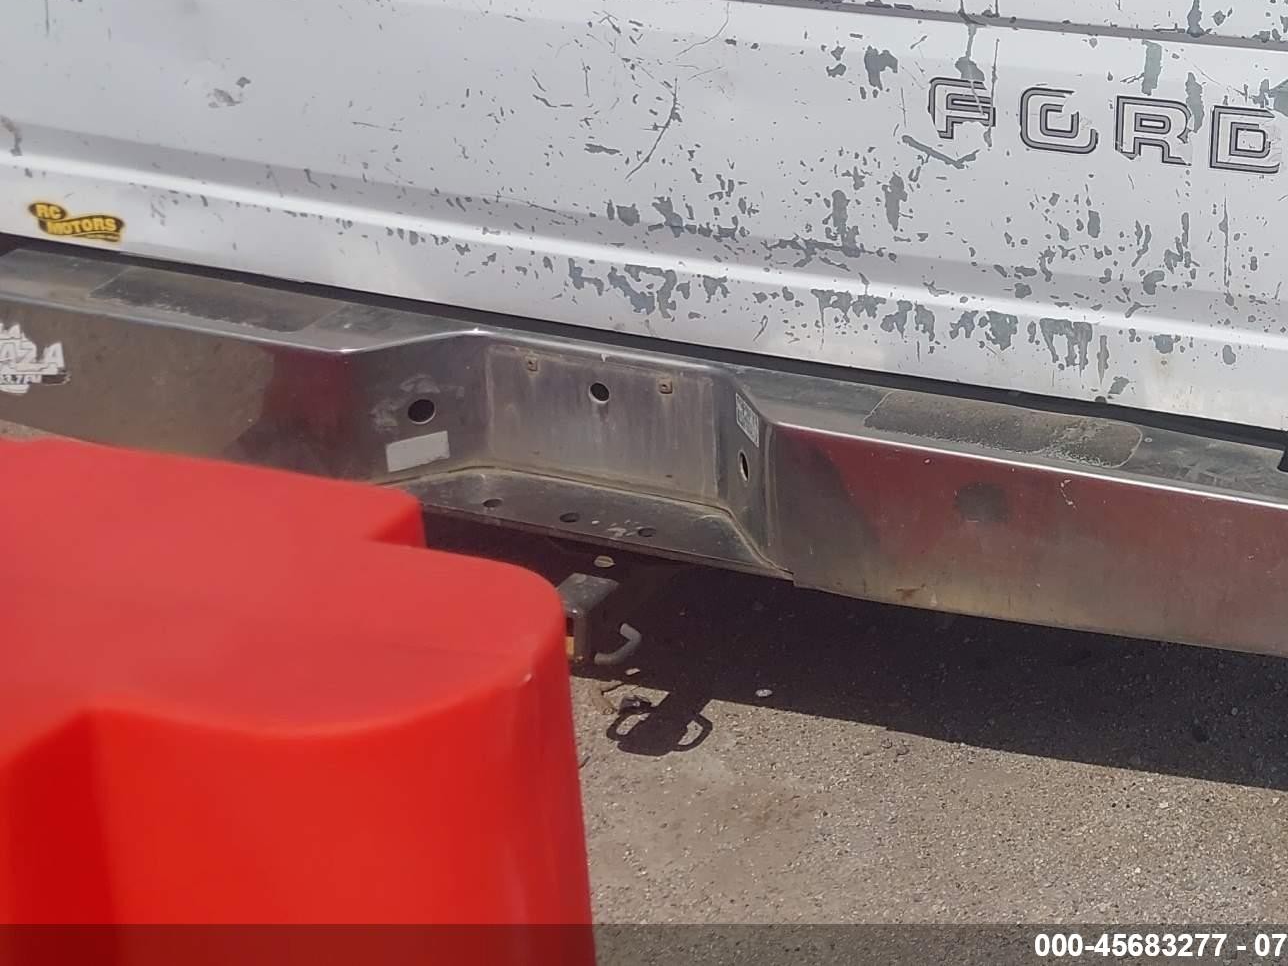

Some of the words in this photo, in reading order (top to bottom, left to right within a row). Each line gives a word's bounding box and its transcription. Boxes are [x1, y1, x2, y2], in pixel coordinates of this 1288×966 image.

[928, 76, 1282, 174] FORD
[35, 204, 61, 219] RC
[46, 217, 117, 235] MOTORS
